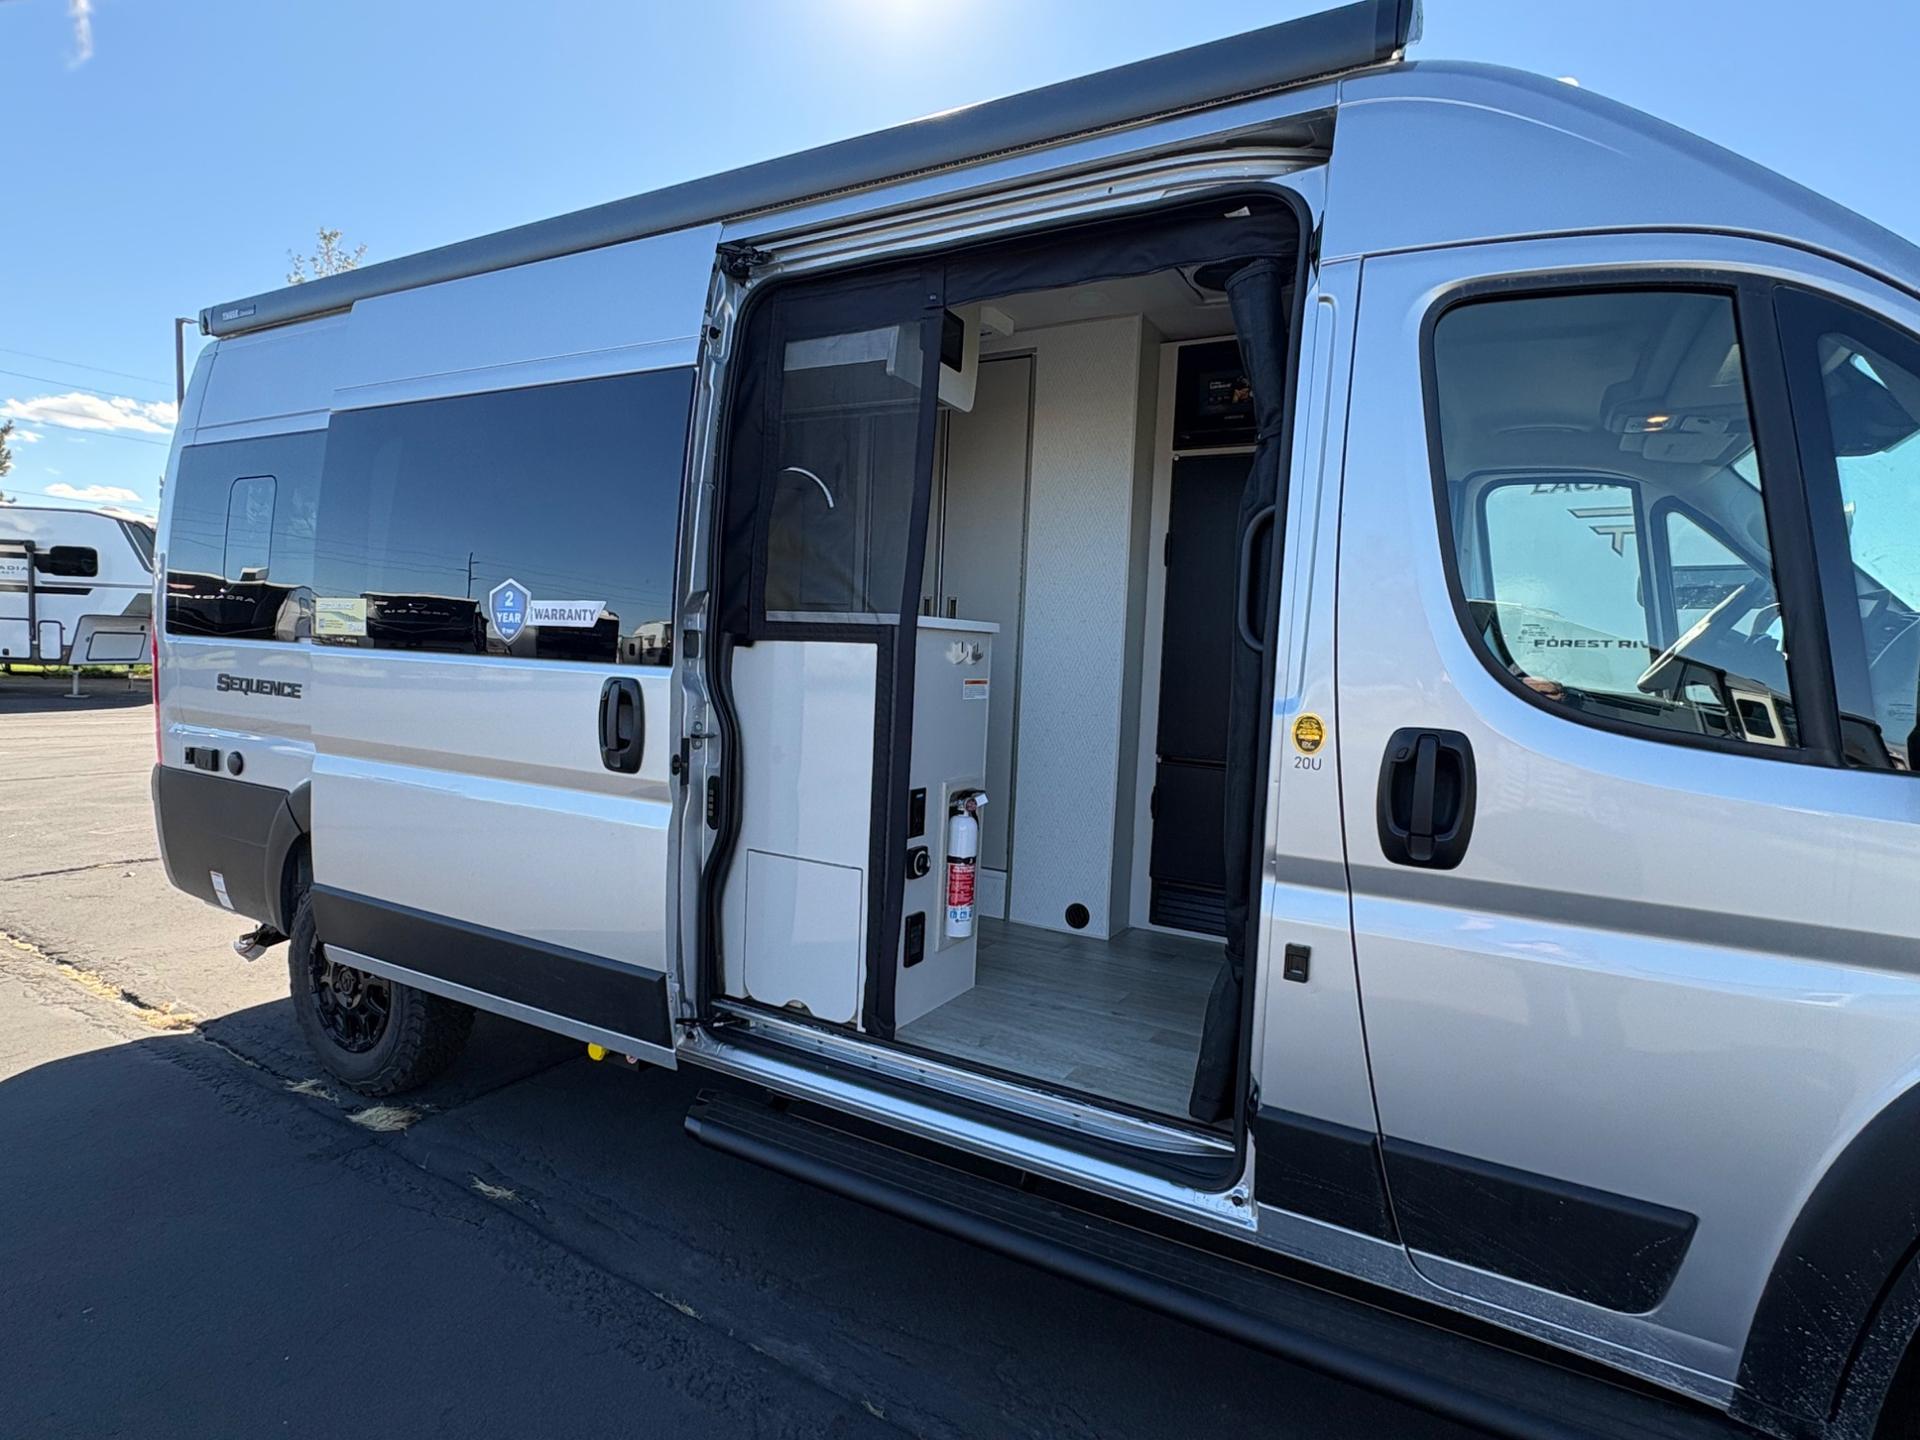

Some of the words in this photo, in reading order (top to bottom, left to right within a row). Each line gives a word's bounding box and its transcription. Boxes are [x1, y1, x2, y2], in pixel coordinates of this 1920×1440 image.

[504, 591, 514, 607] 2
[496, 612, 521, 624] YEAR
[534, 607, 596, 622] WARRANTY
[1534, 639, 1613, 649] FOREST
[1294, 756, 1322, 771] 20U
